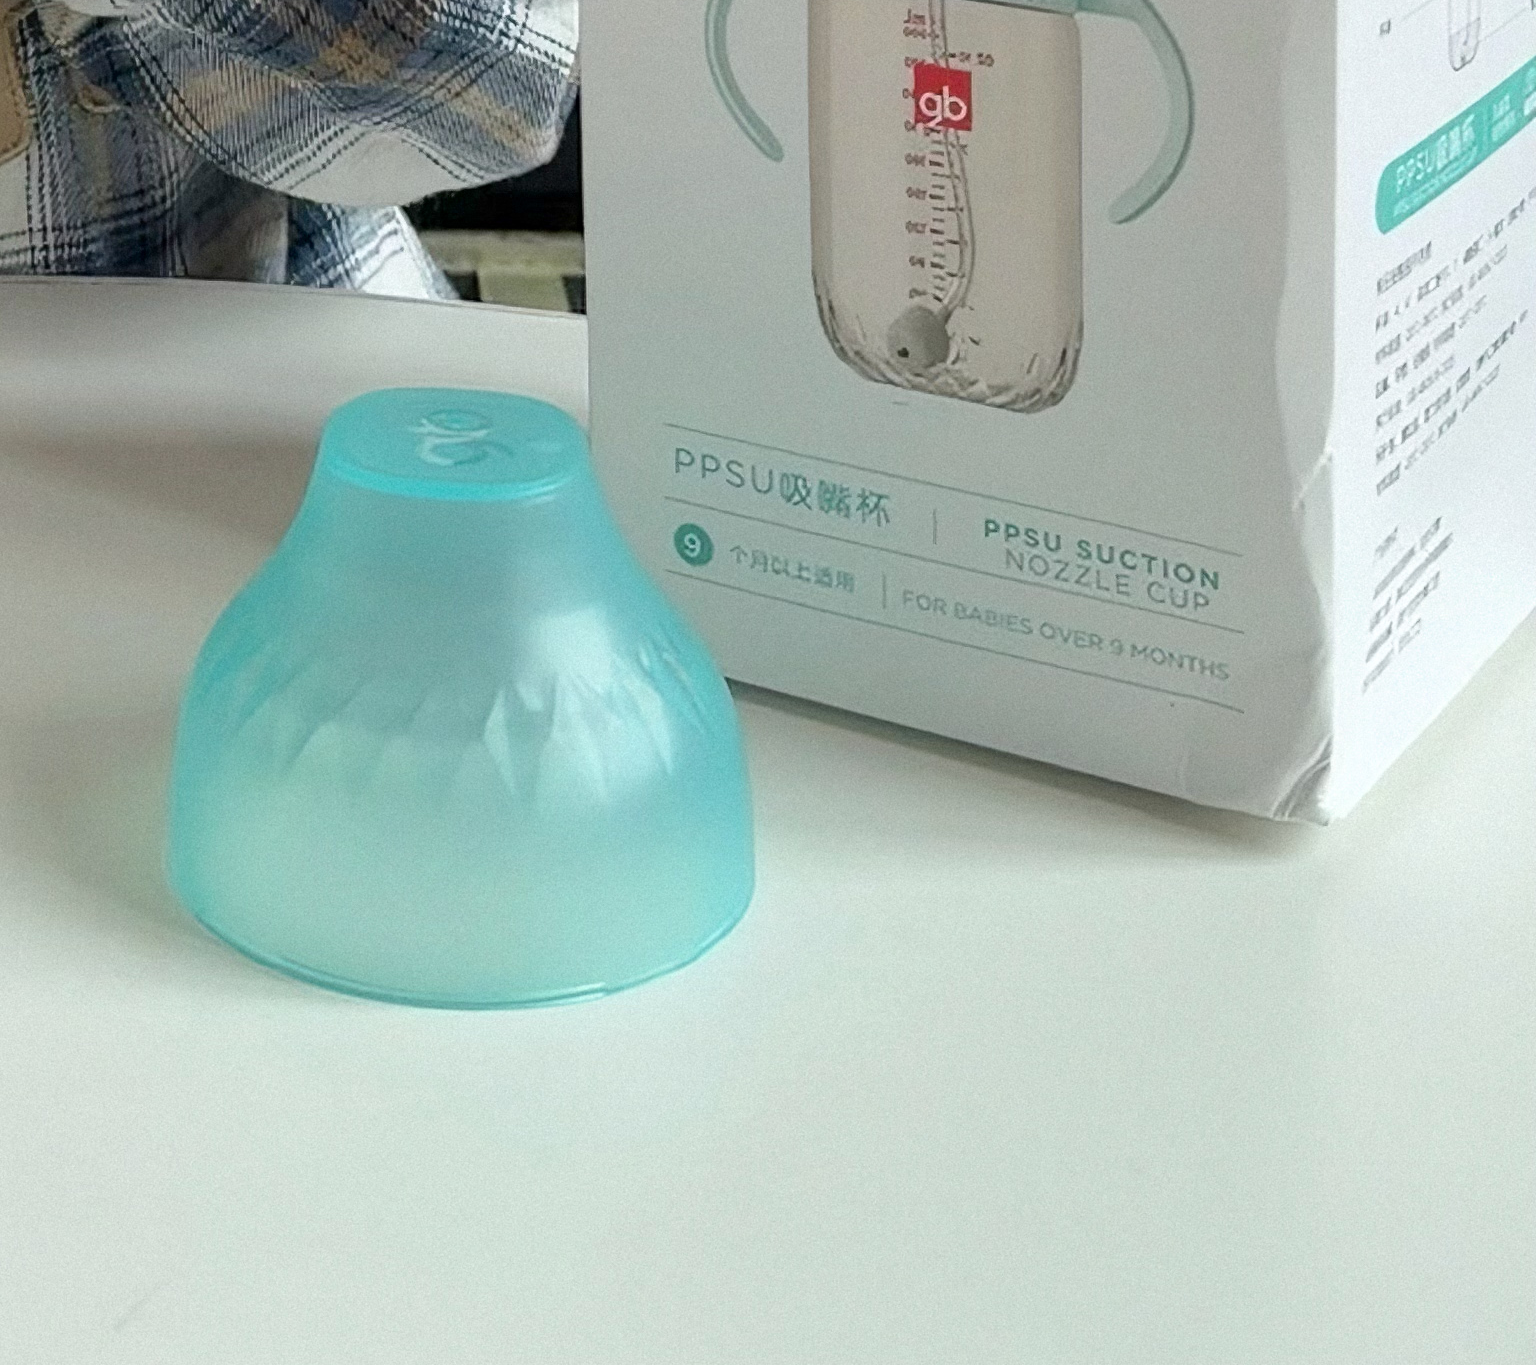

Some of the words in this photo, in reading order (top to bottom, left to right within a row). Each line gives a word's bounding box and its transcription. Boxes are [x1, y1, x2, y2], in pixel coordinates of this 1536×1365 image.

[919, 85, 968, 127] gb
[683, 533, 701, 558] 9
[729, 544, 856, 593] 个月以上适用
[984, 519, 1062, 553] PPSU
[1077, 539, 1220, 591] SUCTION
[1005, 548, 1131, 597] NOZZLE
[1147, 580, 1210, 612] CUP
[902, 589, 947, 616] FOR
[954, 602, 1034, 636] BABIES
[1040, 621, 1103, 651] OVER
[1110, 638, 1124, 656] 9
[1130, 642, 1231, 682] MONTHS
